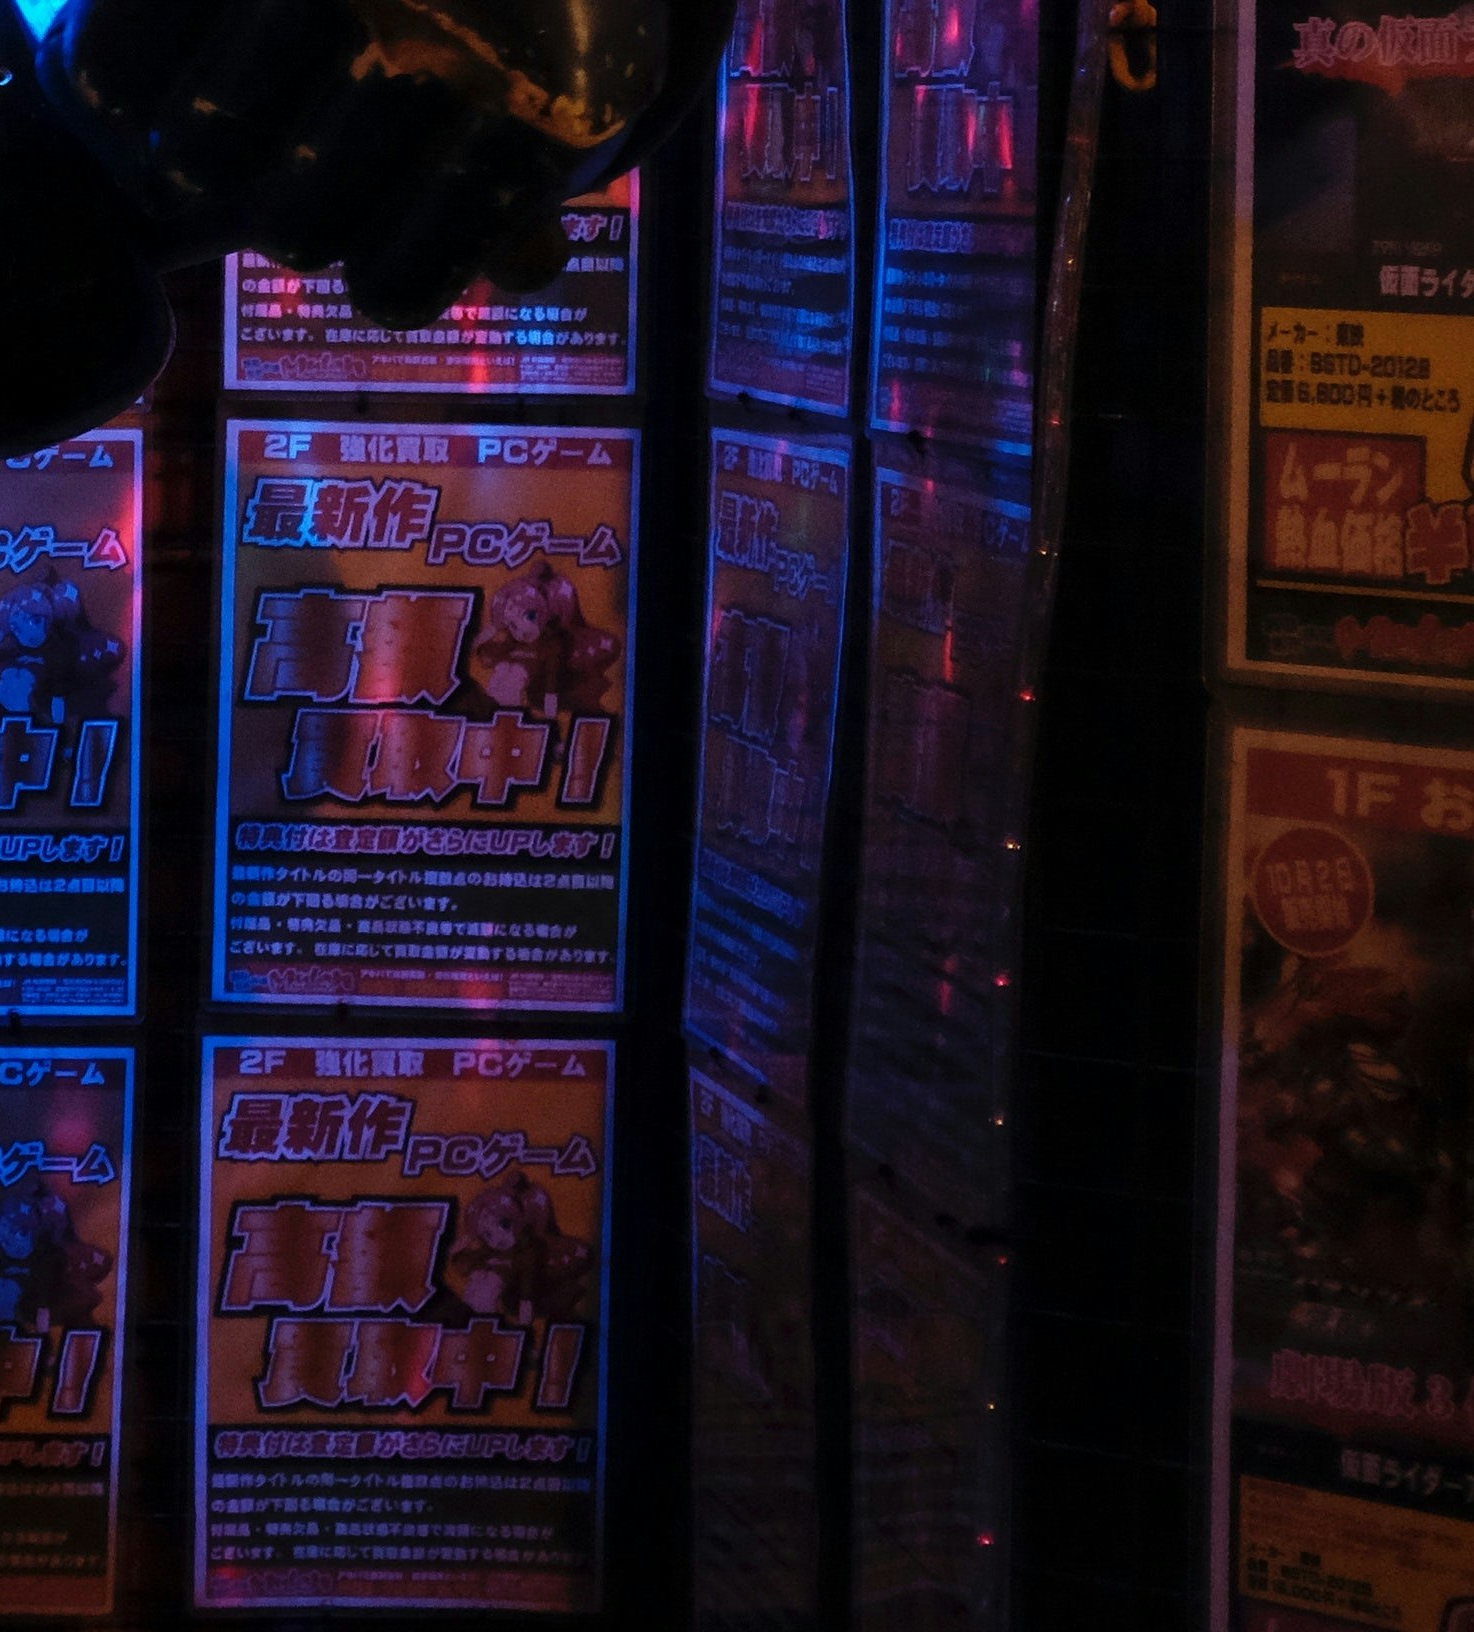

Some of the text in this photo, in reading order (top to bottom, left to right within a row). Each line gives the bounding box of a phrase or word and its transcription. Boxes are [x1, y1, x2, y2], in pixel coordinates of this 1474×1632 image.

[263, 433, 613, 468] 2F 強化買取 PCゲーム
[1278, 442, 1402, 505] ムーラン
[242, 476, 623, 570] 最新作 PCゲーム
[1325, 768, 1402, 817] 1F
[240, 1048, 588, 1081] 2F 強化買取 PCゲーム
[220, 1091, 598, 1181] 最新作 PCゲーム
